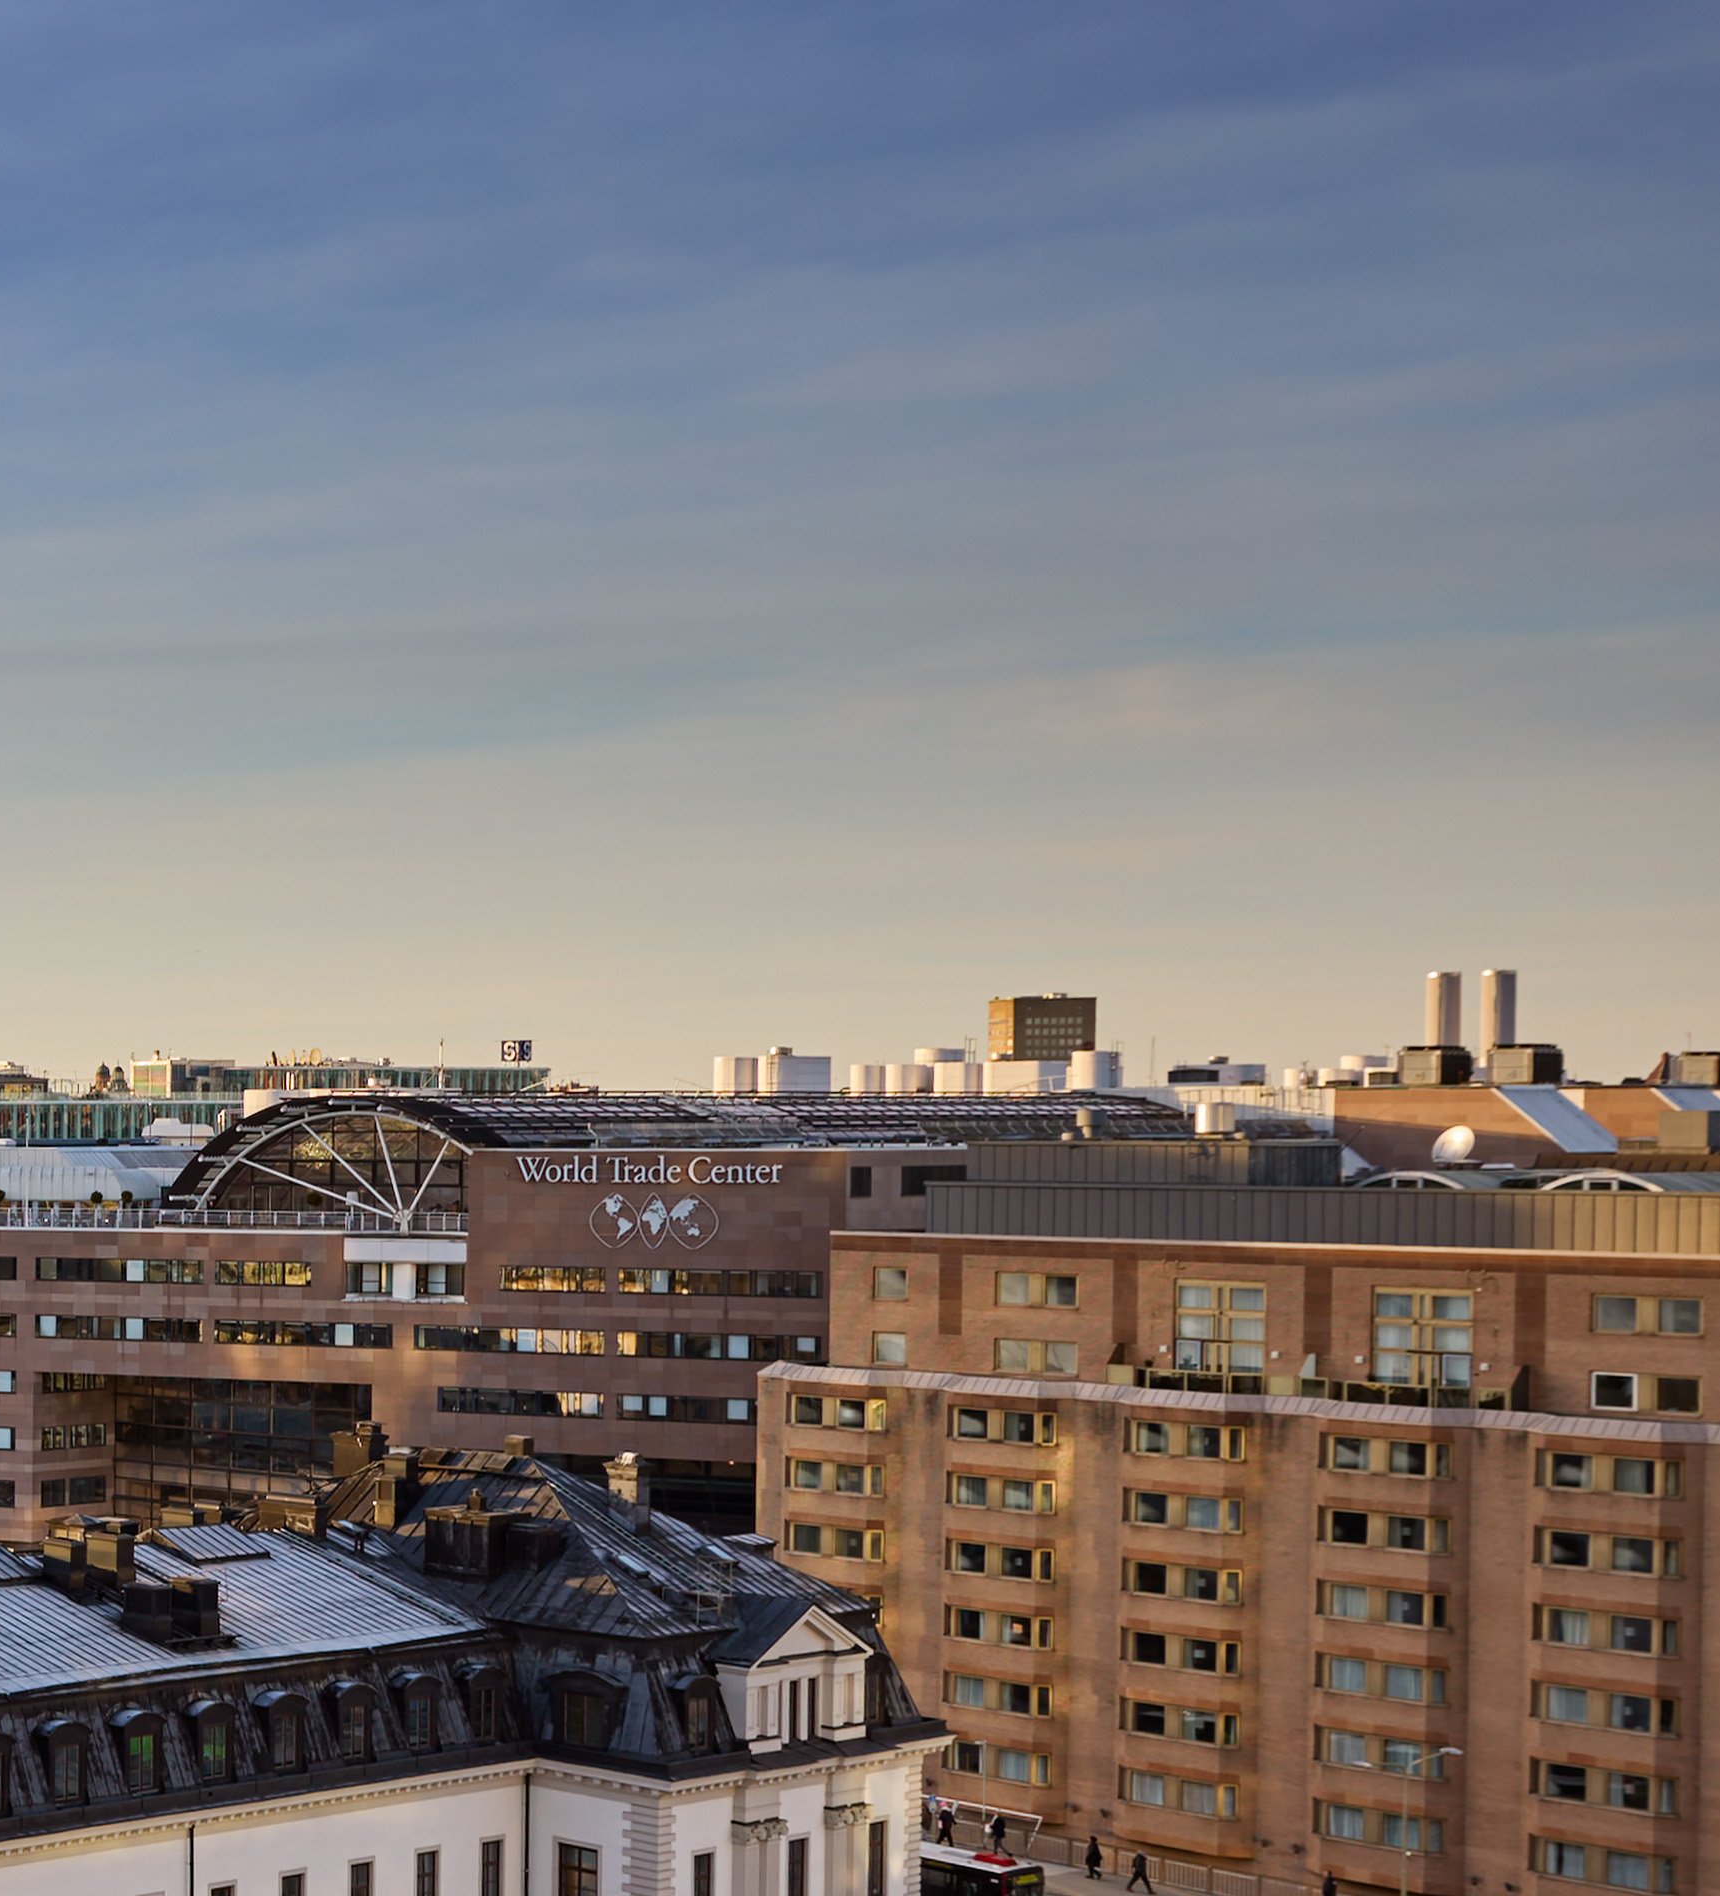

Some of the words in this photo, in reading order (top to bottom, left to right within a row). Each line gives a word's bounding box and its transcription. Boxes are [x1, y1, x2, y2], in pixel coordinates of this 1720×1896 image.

[517, 1155, 598, 1184] World
[607, 1155, 681, 1184] Trade
[688, 1155, 782, 1184] Center
